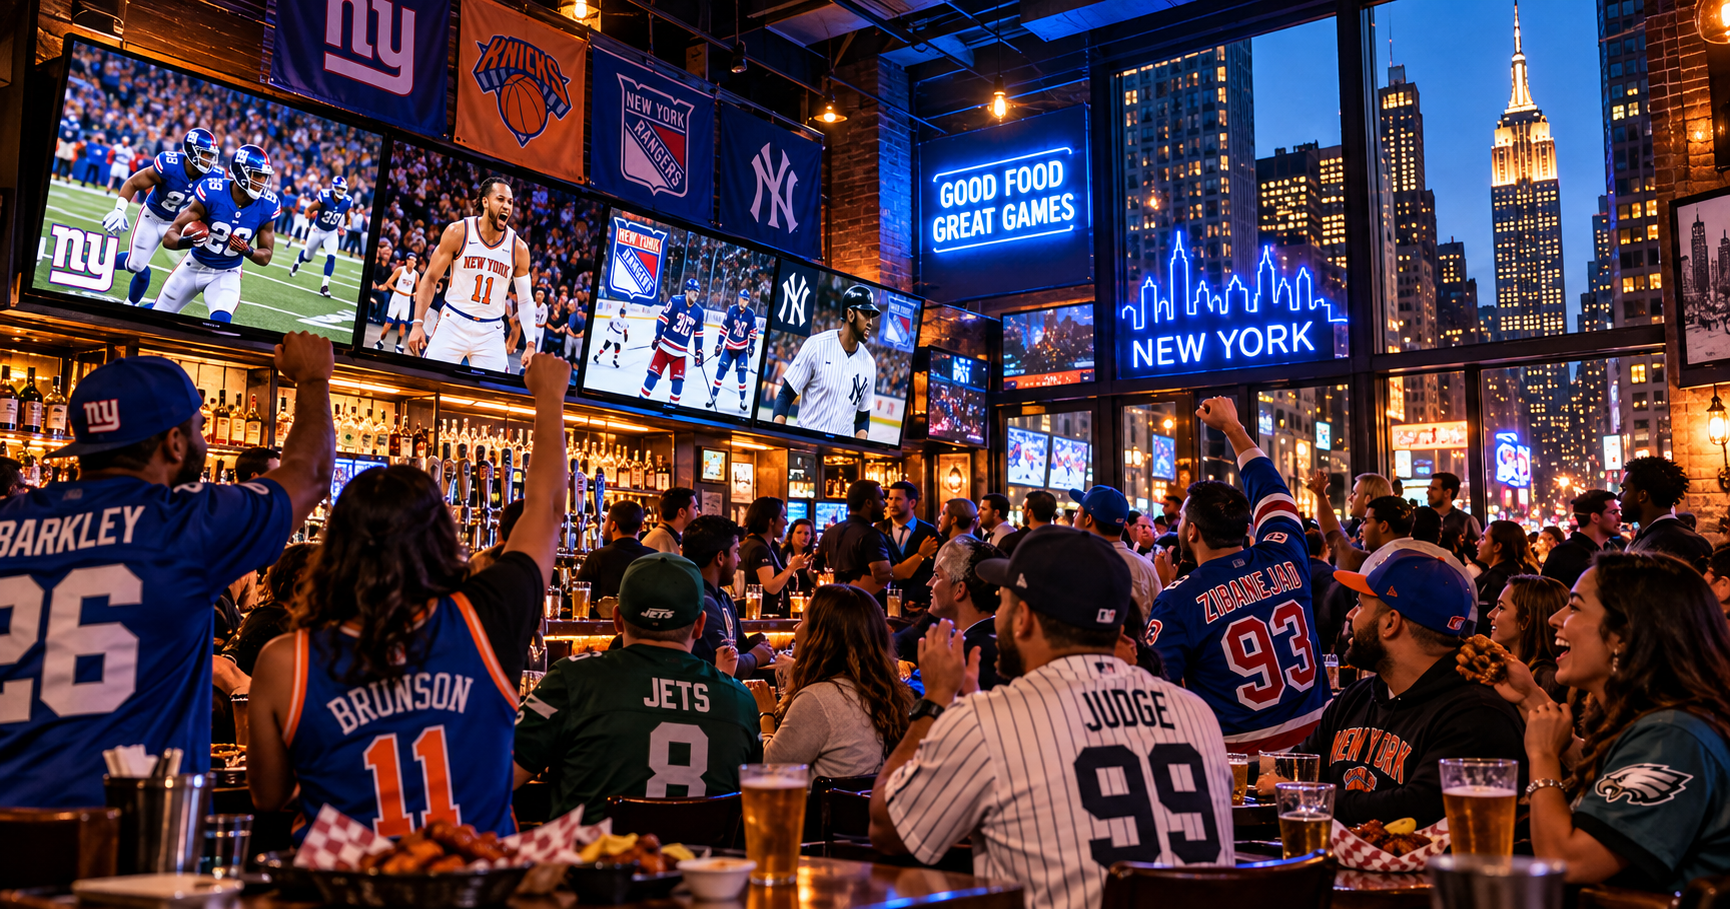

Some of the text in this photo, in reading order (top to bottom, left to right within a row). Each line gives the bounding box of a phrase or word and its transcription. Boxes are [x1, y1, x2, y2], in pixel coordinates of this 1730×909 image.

[476, 37, 569, 107] KNICKS
[626, 90, 685, 128] NEW YORK
[634, 119, 682, 187] RANGERS
[749, 141, 799, 234] NY
[940, 160, 1064, 208] GOOD FOOD
[933, 193, 1075, 243] GREAT GAMES
[463, 256, 511, 279] NEW YORK
[471, 274, 494, 305] 11
[778, 272, 811, 327] NY
[1133, 320, 1316, 368] NEW YORK
[0, 505, 146, 558] BARKLEY
[640, 607, 675, 619] JETS
[1196, 561, 1303, 625] ZIBANEJAD
[1220, 599, 1317, 712] 93
[326, 672, 474, 736] BRUNSON
[643, 677, 710, 713] JETS
[1082, 689, 1176, 732] JUDGE
[363, 724, 462, 837] 11
[645, 721, 709, 798] 8
[1328, 727, 1370, 768] NEW
[1364, 727, 1413, 785] YORK
[1073, 743, 1222, 869] 99
